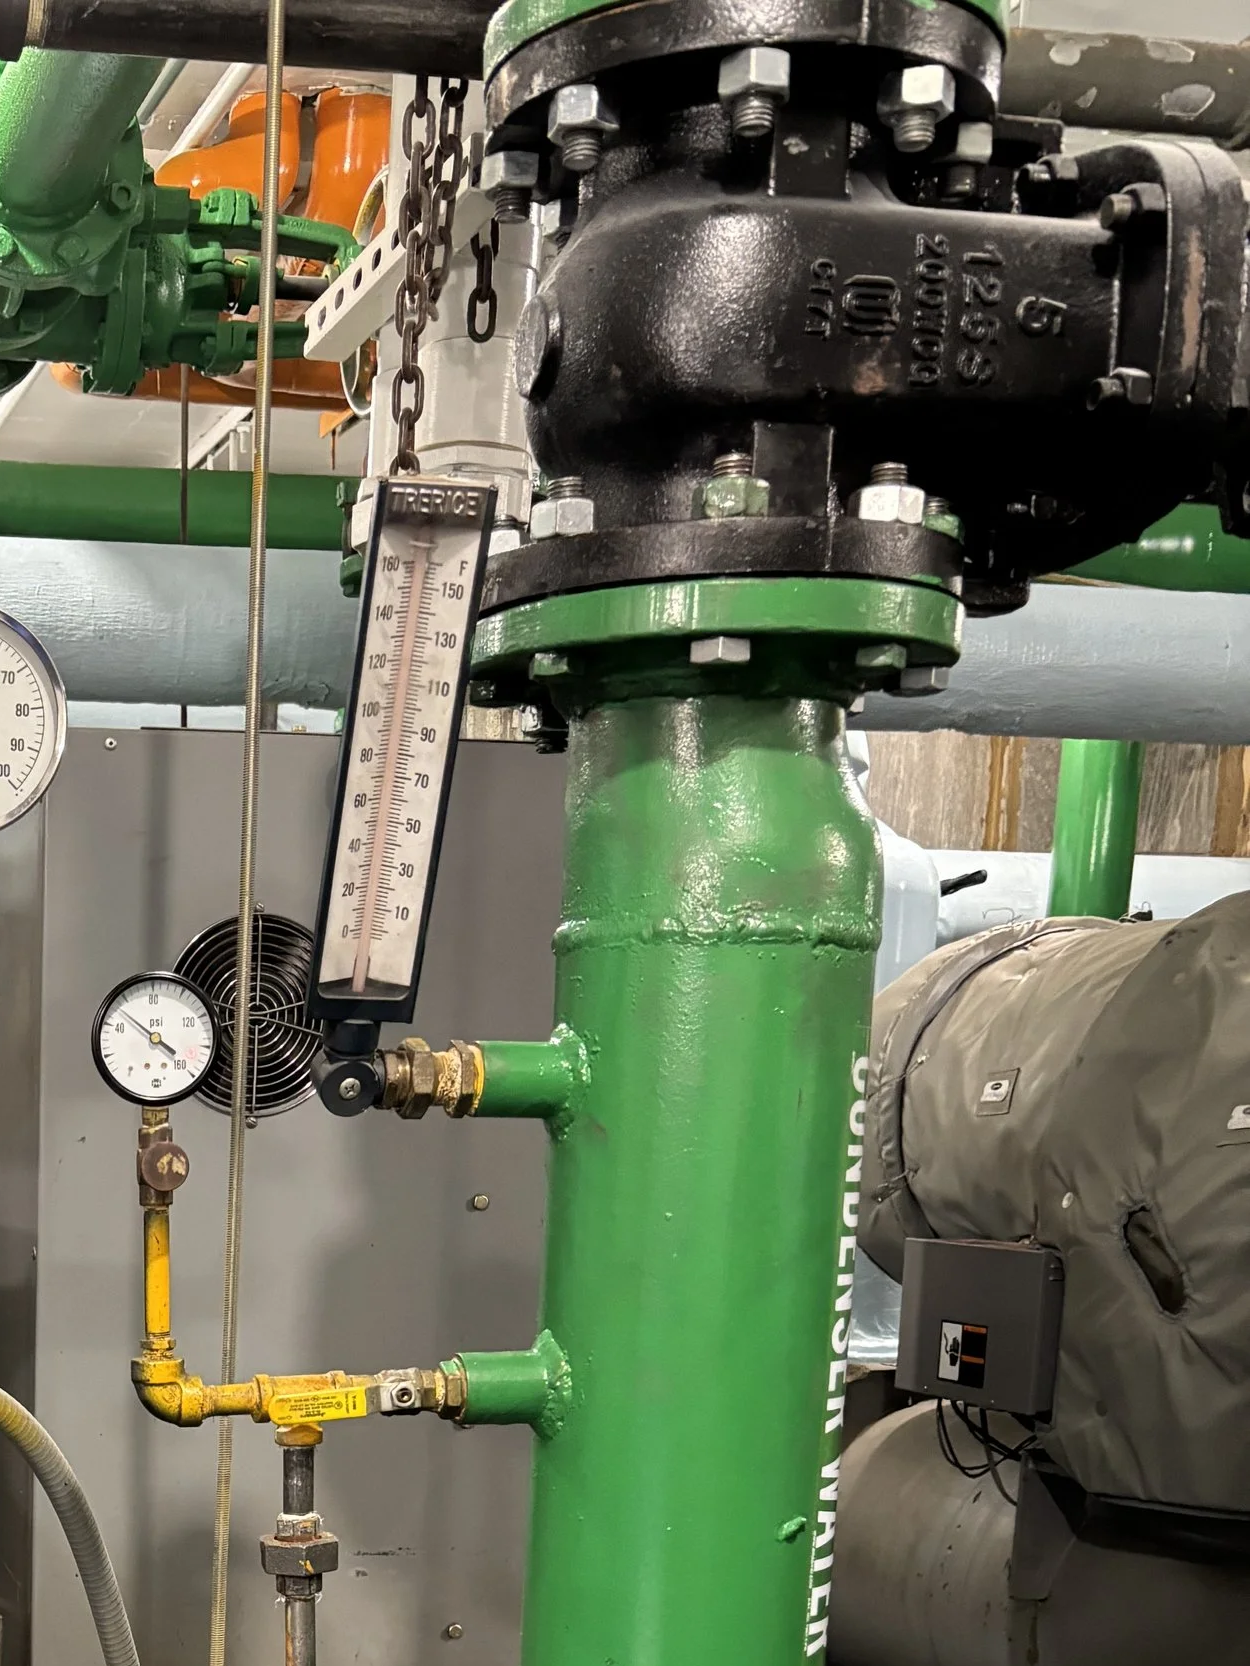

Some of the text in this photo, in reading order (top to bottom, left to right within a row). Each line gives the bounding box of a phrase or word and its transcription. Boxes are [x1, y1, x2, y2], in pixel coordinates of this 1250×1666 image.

[1016, 295, 1068, 336] 5
[391, 487, 479, 516] TRERICE
[382, 557, 400, 573] 160
[459, 561, 468, 576] F
[442, 583, 463, 600] 150
[375, 605, 393, 621] 140
[434, 632, 457, 649] 130
[368, 654, 387, 670] 120
[1, 671, 15, 685] 70
[428, 681, 450, 697] 110
[16, 703, 30, 717] 80
[361, 702, 380, 717] 100
[420, 727, 436, 743] 90
[10, 738, 25, 752] 90
[360, 748, 373, 762] 80
[414, 773, 429, 789] 70
[354, 793, 367, 808] 60
[405, 818, 421, 834] 50
[348, 838, 361, 852] 40
[399, 863, 414, 878] 30
[342, 883, 354, 897] 20
[395, 906, 409, 921] 10
[342, 924, 348, 938] 0
[115, 1022, 125, 1033] 40
[149, 1017, 163, 1028] psi
[182, 1017, 195, 1028] 120
[173, 1059, 187, 1070] 160
